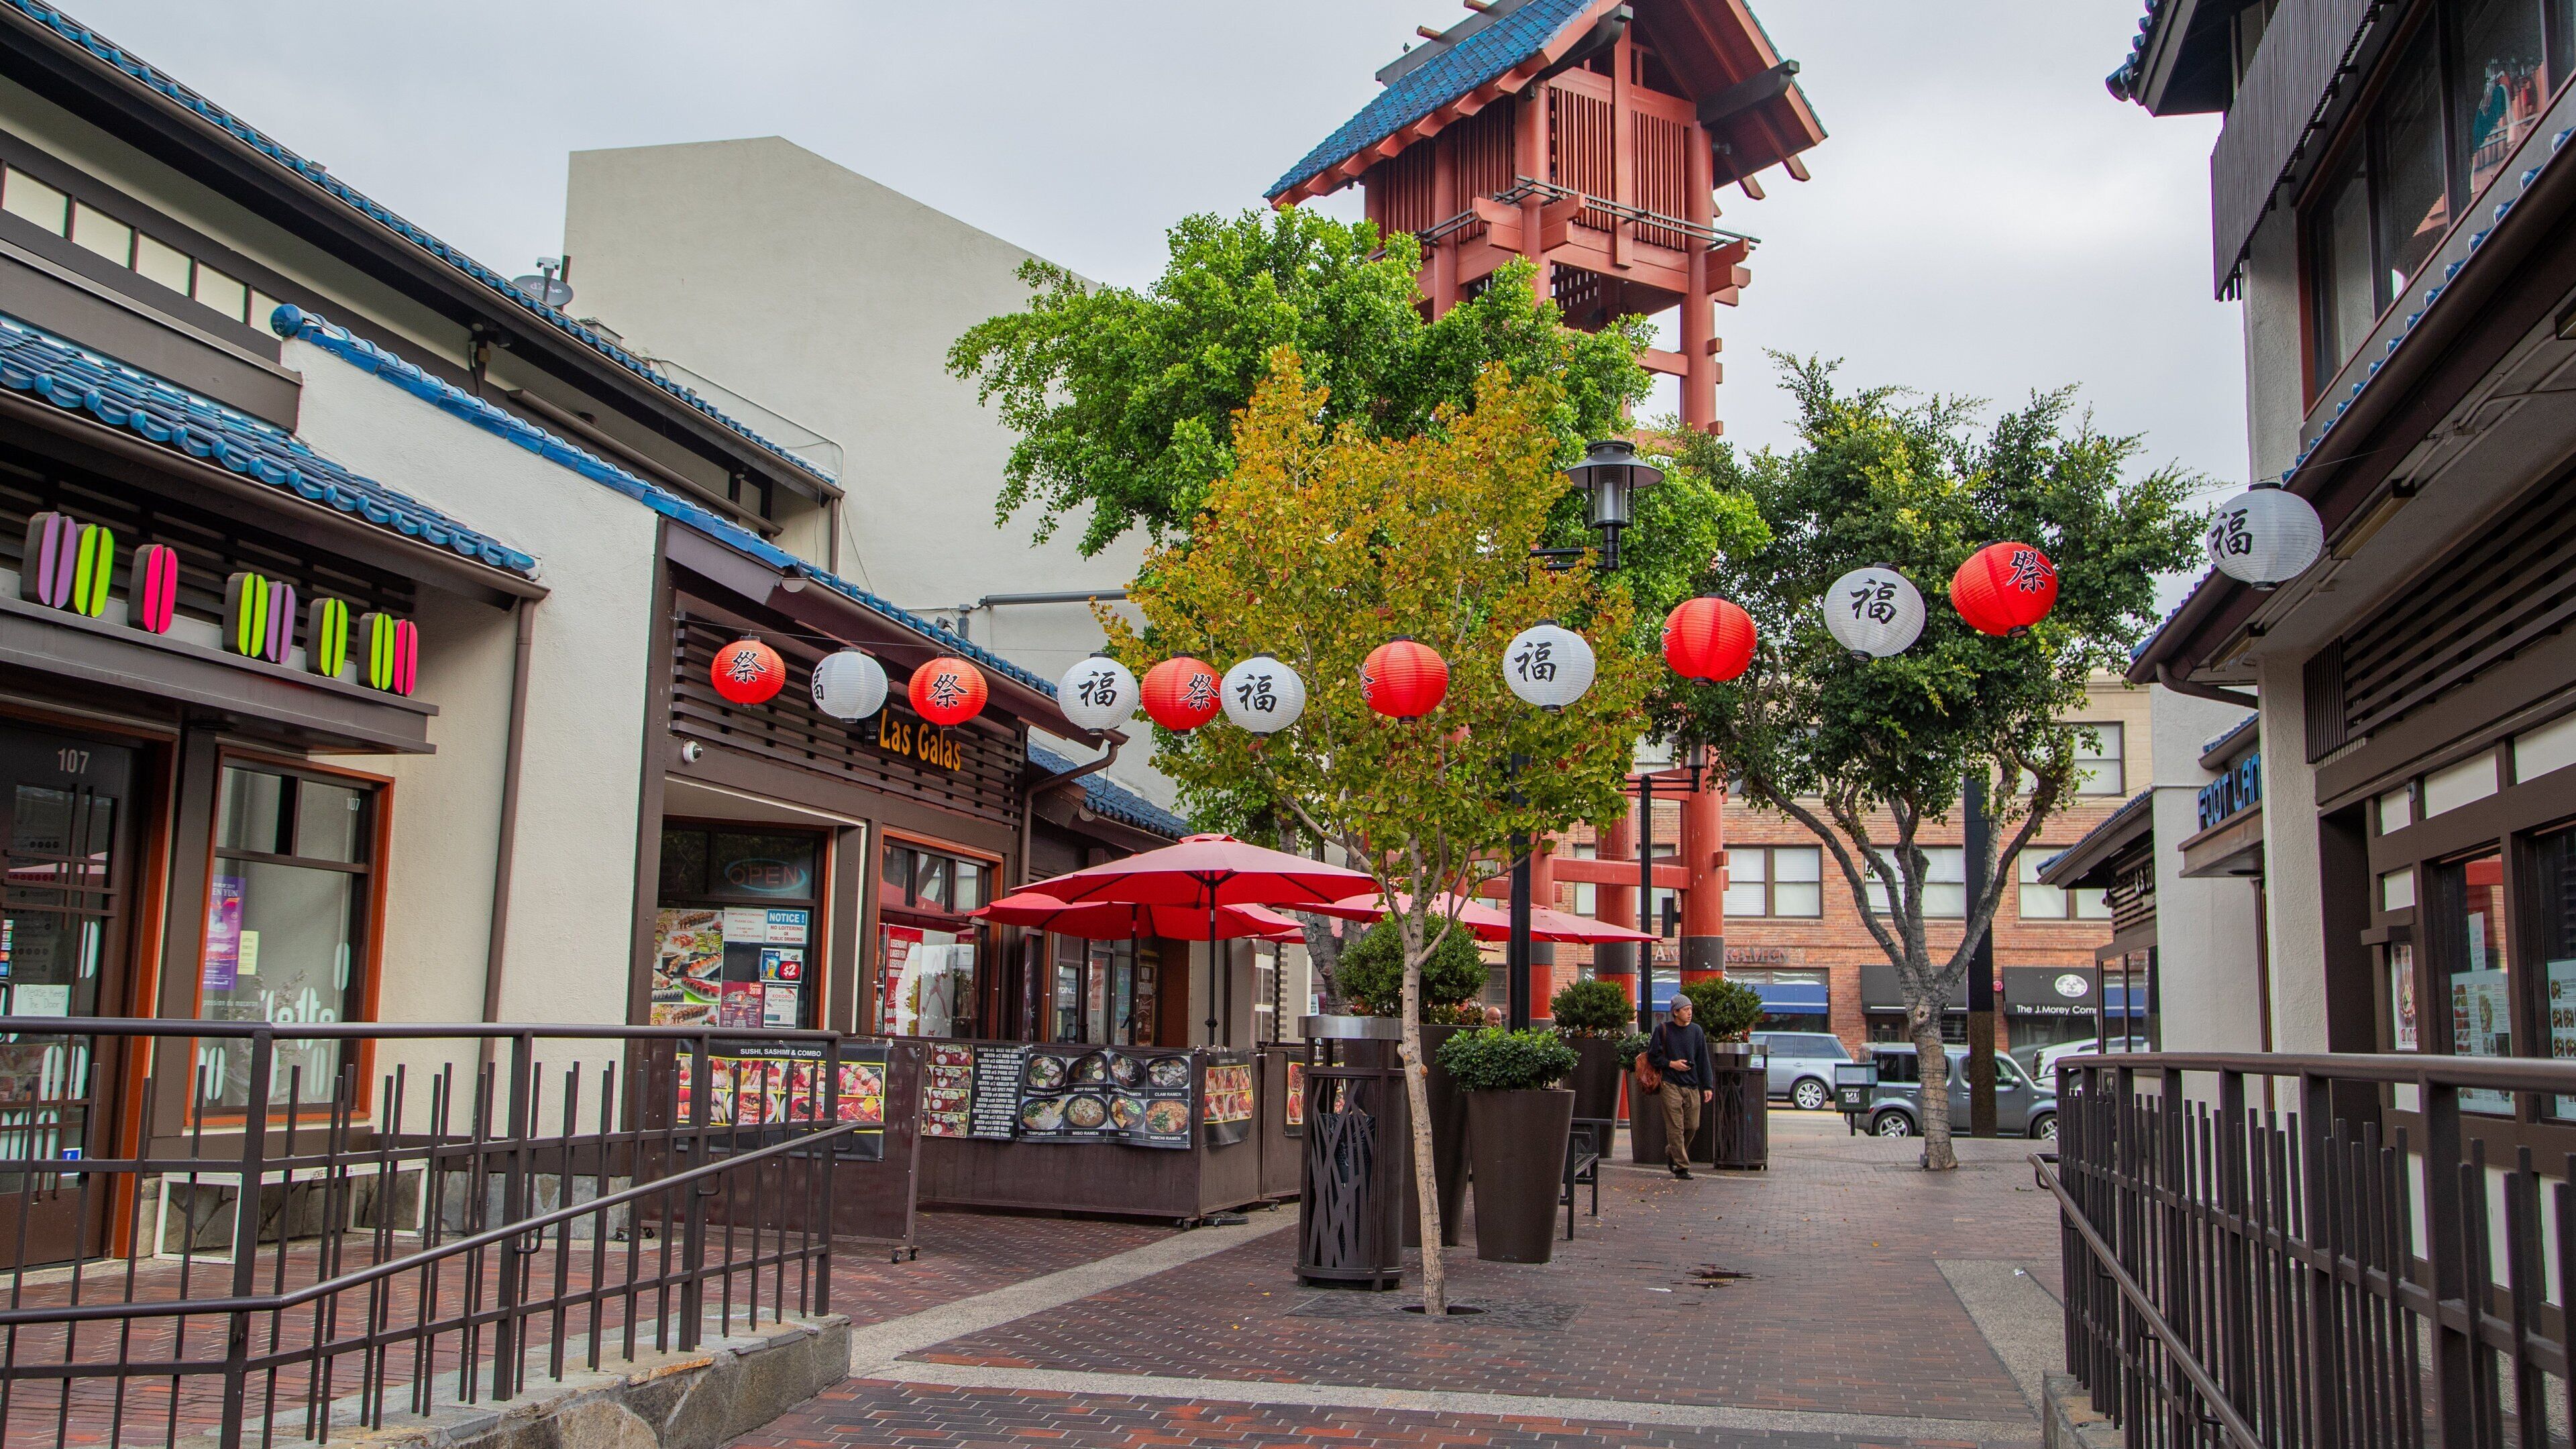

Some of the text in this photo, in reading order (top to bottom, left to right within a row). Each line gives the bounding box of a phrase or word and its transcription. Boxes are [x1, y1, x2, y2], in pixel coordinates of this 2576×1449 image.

[2210, 508, 2253, 559] 福
[2007, 550, 2053, 593] 祭
[1849, 578, 1898, 625] 福
[727, 650, 765, 684] 祭
[1513, 641, 1556, 682] 福
[926, 673, 967, 709] 祭
[1077, 671, 1116, 706] 福
[1179, 673, 1220, 711] 祭
[1236, 674, 1277, 712] 福
[879, 708, 961, 771] Las Galas
[58, 748, 89, 773] 107
[347, 798, 360, 810] 107
[2198, 771, 2231, 832] FOOT
[729, 866, 797, 885] OPEN
[223, 889, 238, 897] YUN
[769, 912, 800, 923] NOTICE
[784, 964, 796, 976] $2
[1725, 947, 1790, 964] RAMEN
[23, 985, 66, 998] Please Keep
[29, 998, 60, 1008] The Door
[2017, 1005, 2032, 1014] The
